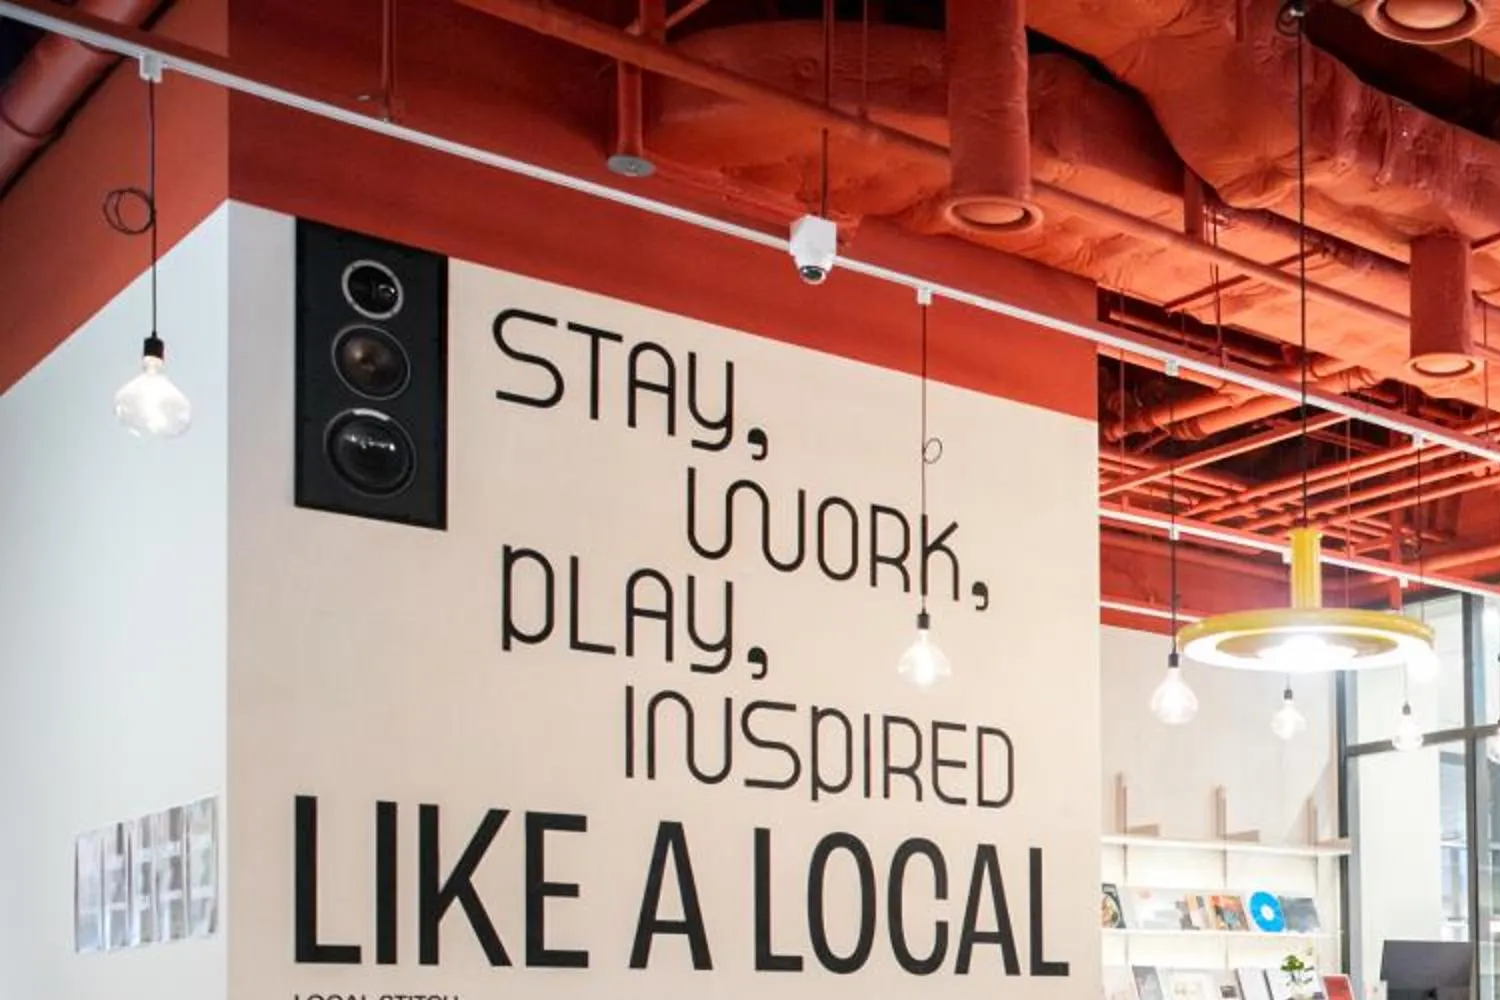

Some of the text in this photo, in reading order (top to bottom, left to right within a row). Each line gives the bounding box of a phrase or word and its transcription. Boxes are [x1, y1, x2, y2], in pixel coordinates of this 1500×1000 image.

[493, 308, 768, 461] STAY,
[687, 466, 989, 611] WORK,
[503, 544, 768, 680] PLAY,
[625, 685, 1015, 809] INSPIRED
[294, 794, 1070, 978] LIKE A LOCAL
